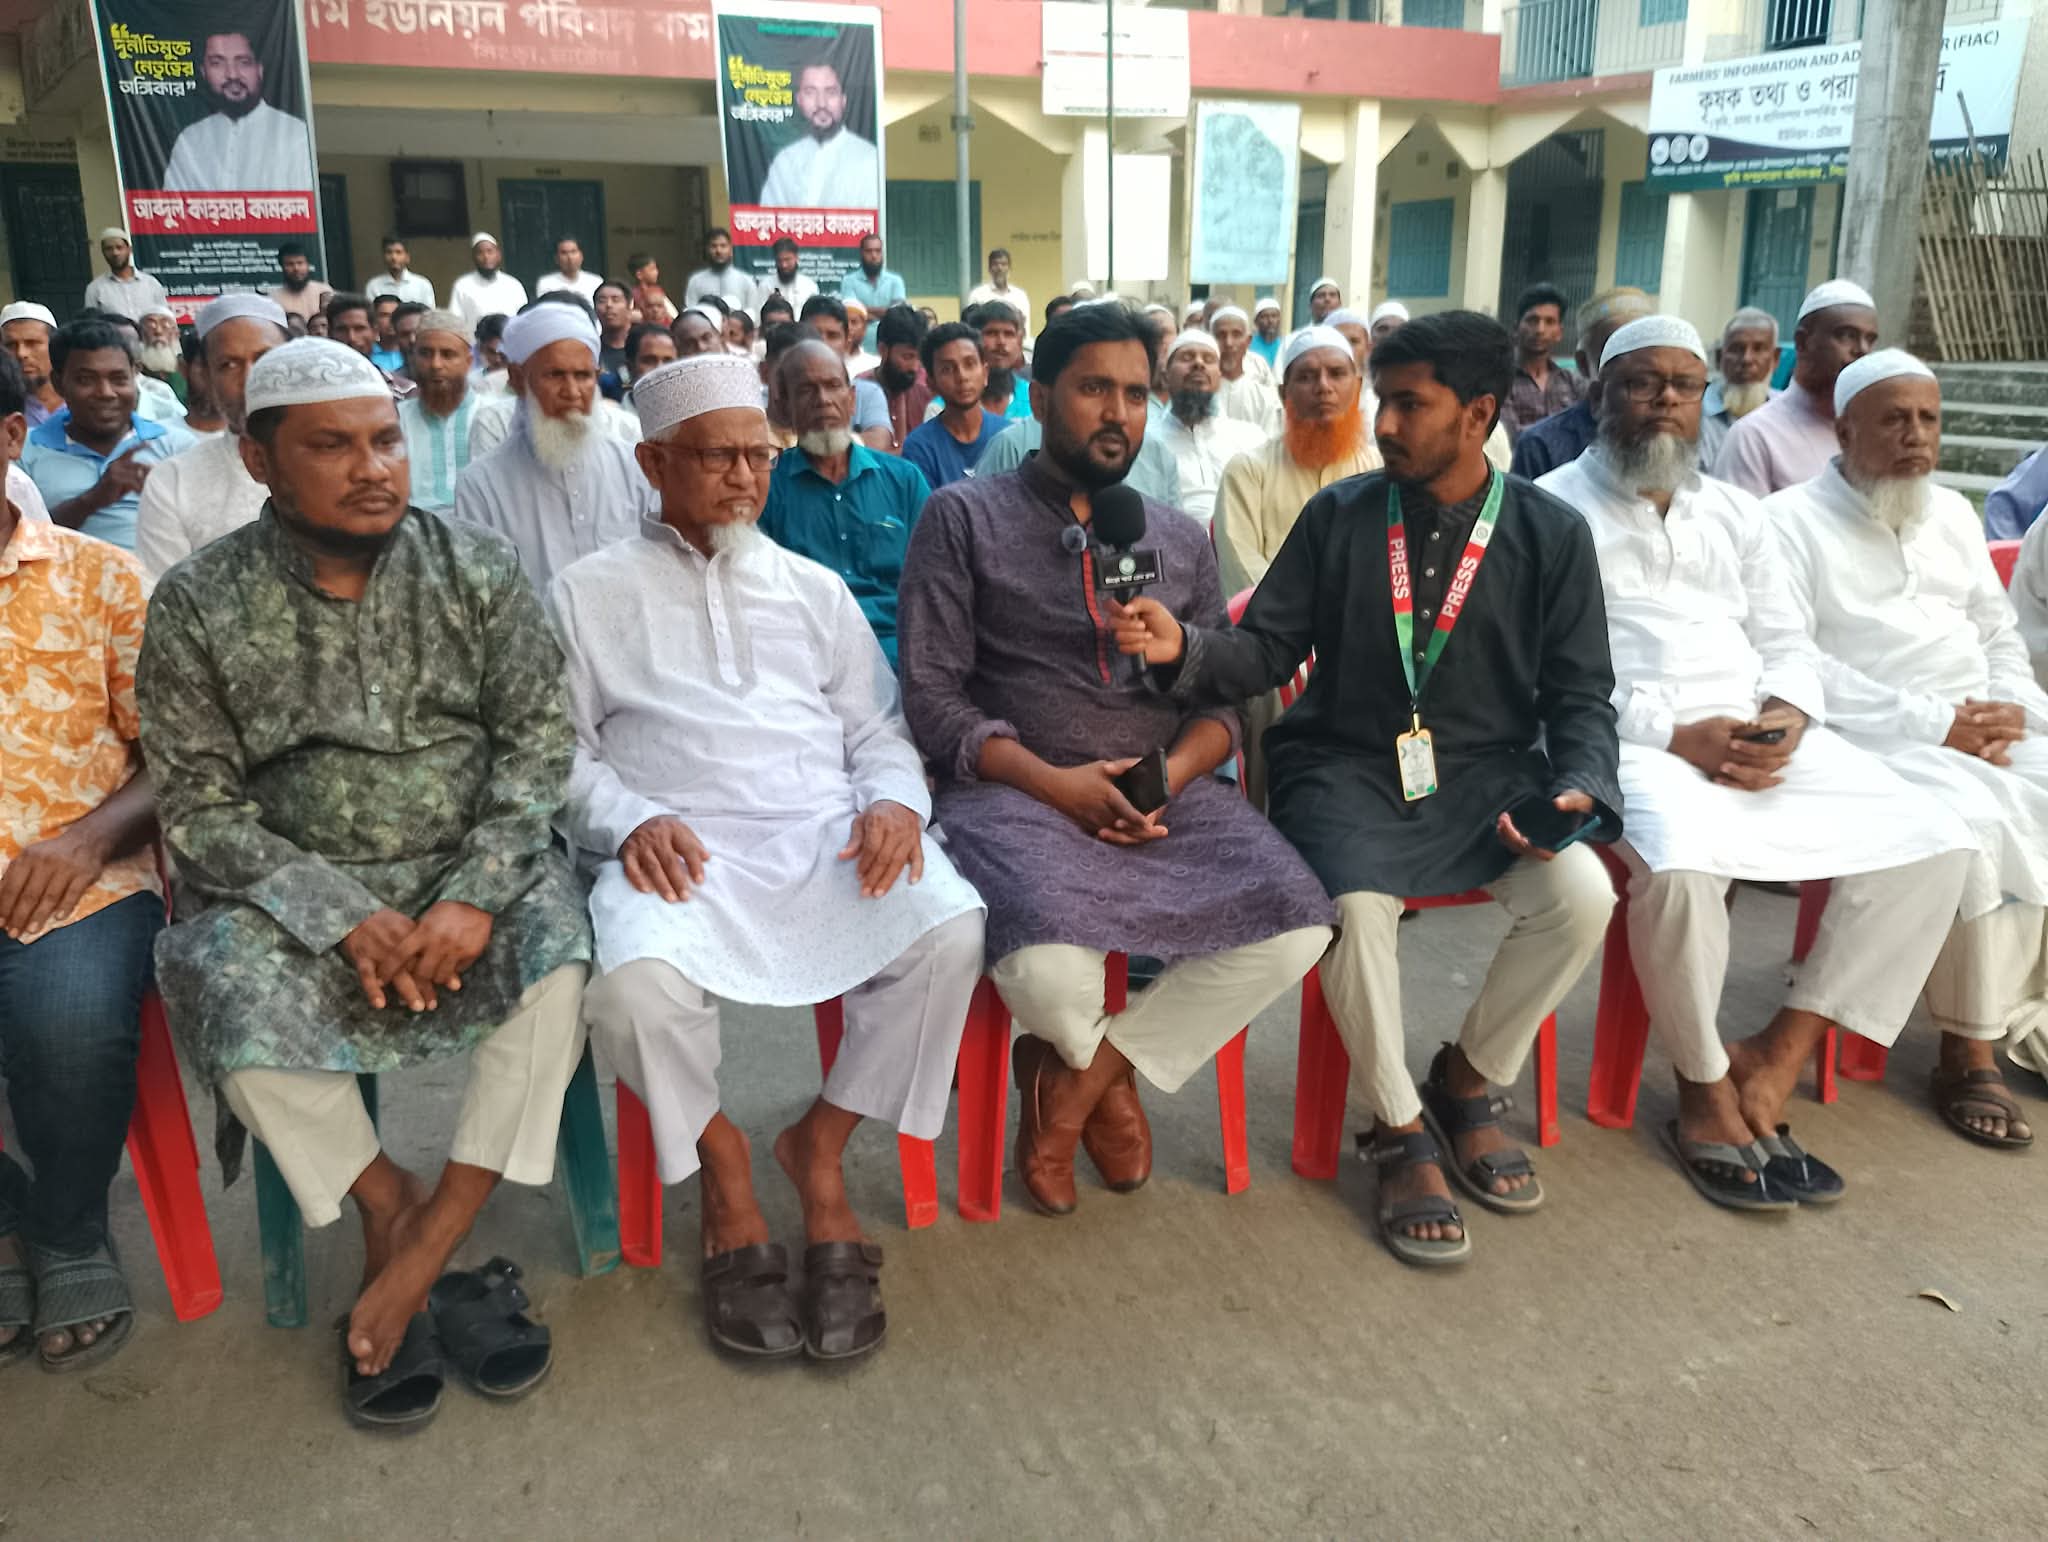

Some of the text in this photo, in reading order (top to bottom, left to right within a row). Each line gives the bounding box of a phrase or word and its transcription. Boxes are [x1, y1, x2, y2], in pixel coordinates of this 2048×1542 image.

[1723, 56, 1807, 78] INFORMATION
[1809, 53, 1838, 67] AND
[1954, 30, 2000, 51] (FIAC)
[1698, 87, 1744, 121] কৃষক
[1750, 80, 1789, 106] তথ্য
[1796, 80, 1811, 102] ও
[1820, 73, 1860, 100] পরা
[1390, 538, 1410, 600] PRESS
[1441, 556, 1478, 618] PRESS
